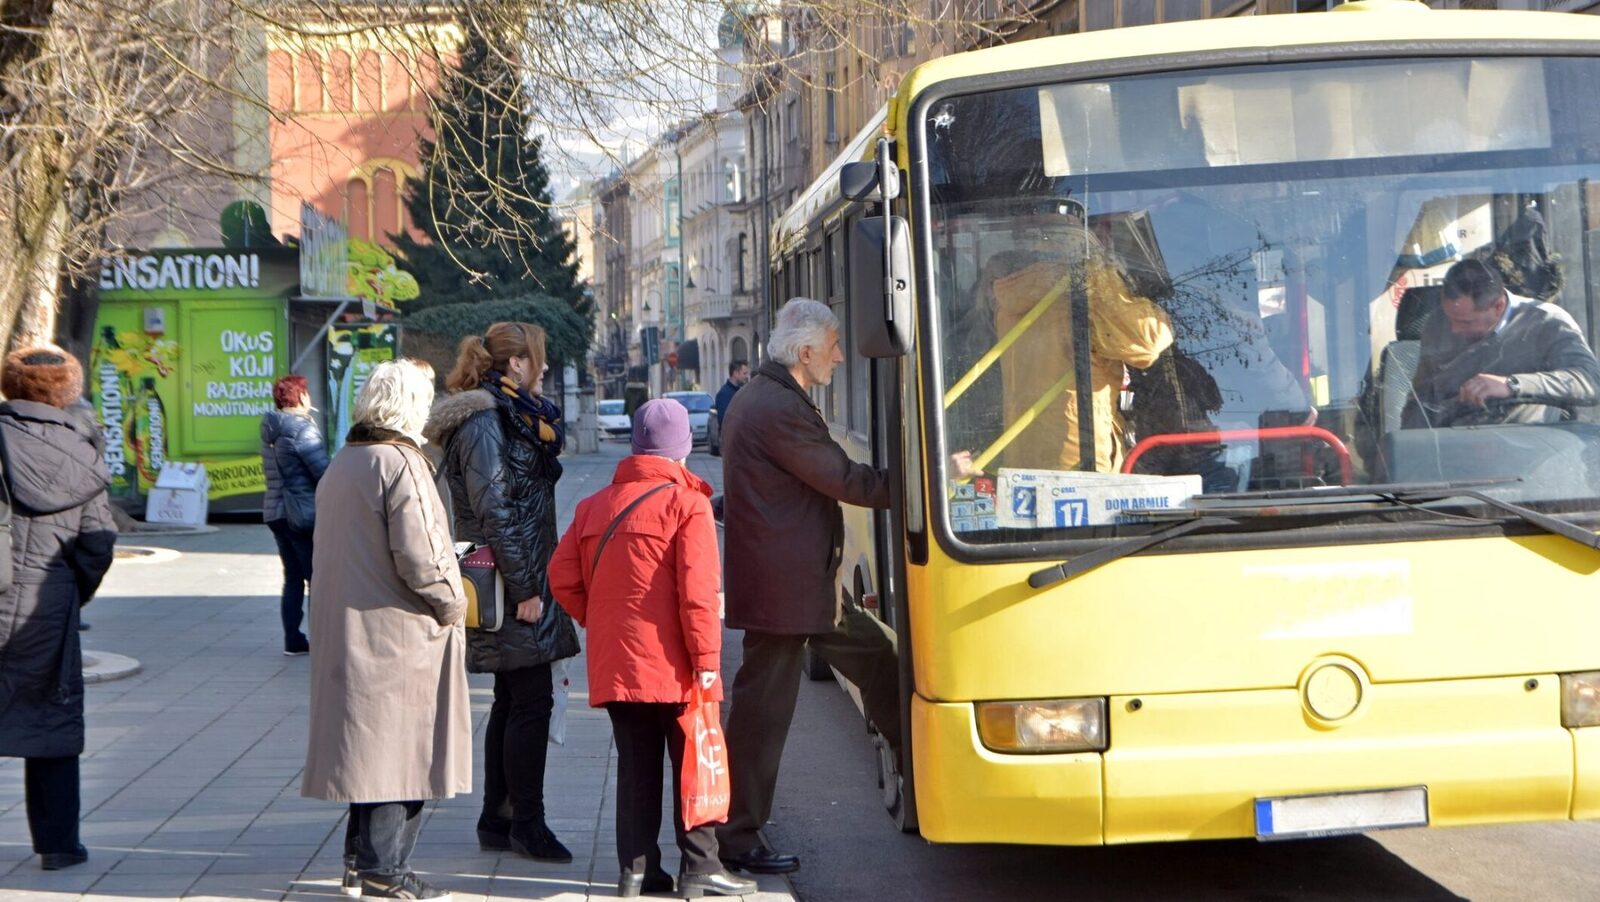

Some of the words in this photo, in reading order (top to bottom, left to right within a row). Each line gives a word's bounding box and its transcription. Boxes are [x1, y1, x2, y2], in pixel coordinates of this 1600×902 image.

[99, 254, 259, 290] ENSATION!
[229, 354, 274, 377] KOJI
[206, 380, 273, 400] RAZBIJA
[100, 362, 126, 476] SENSATION!
[1060, 501, 1084, 527] 17
[1105, 498, 1129, 511] DOM
[1132, 496, 1169, 509] ARMIJE
